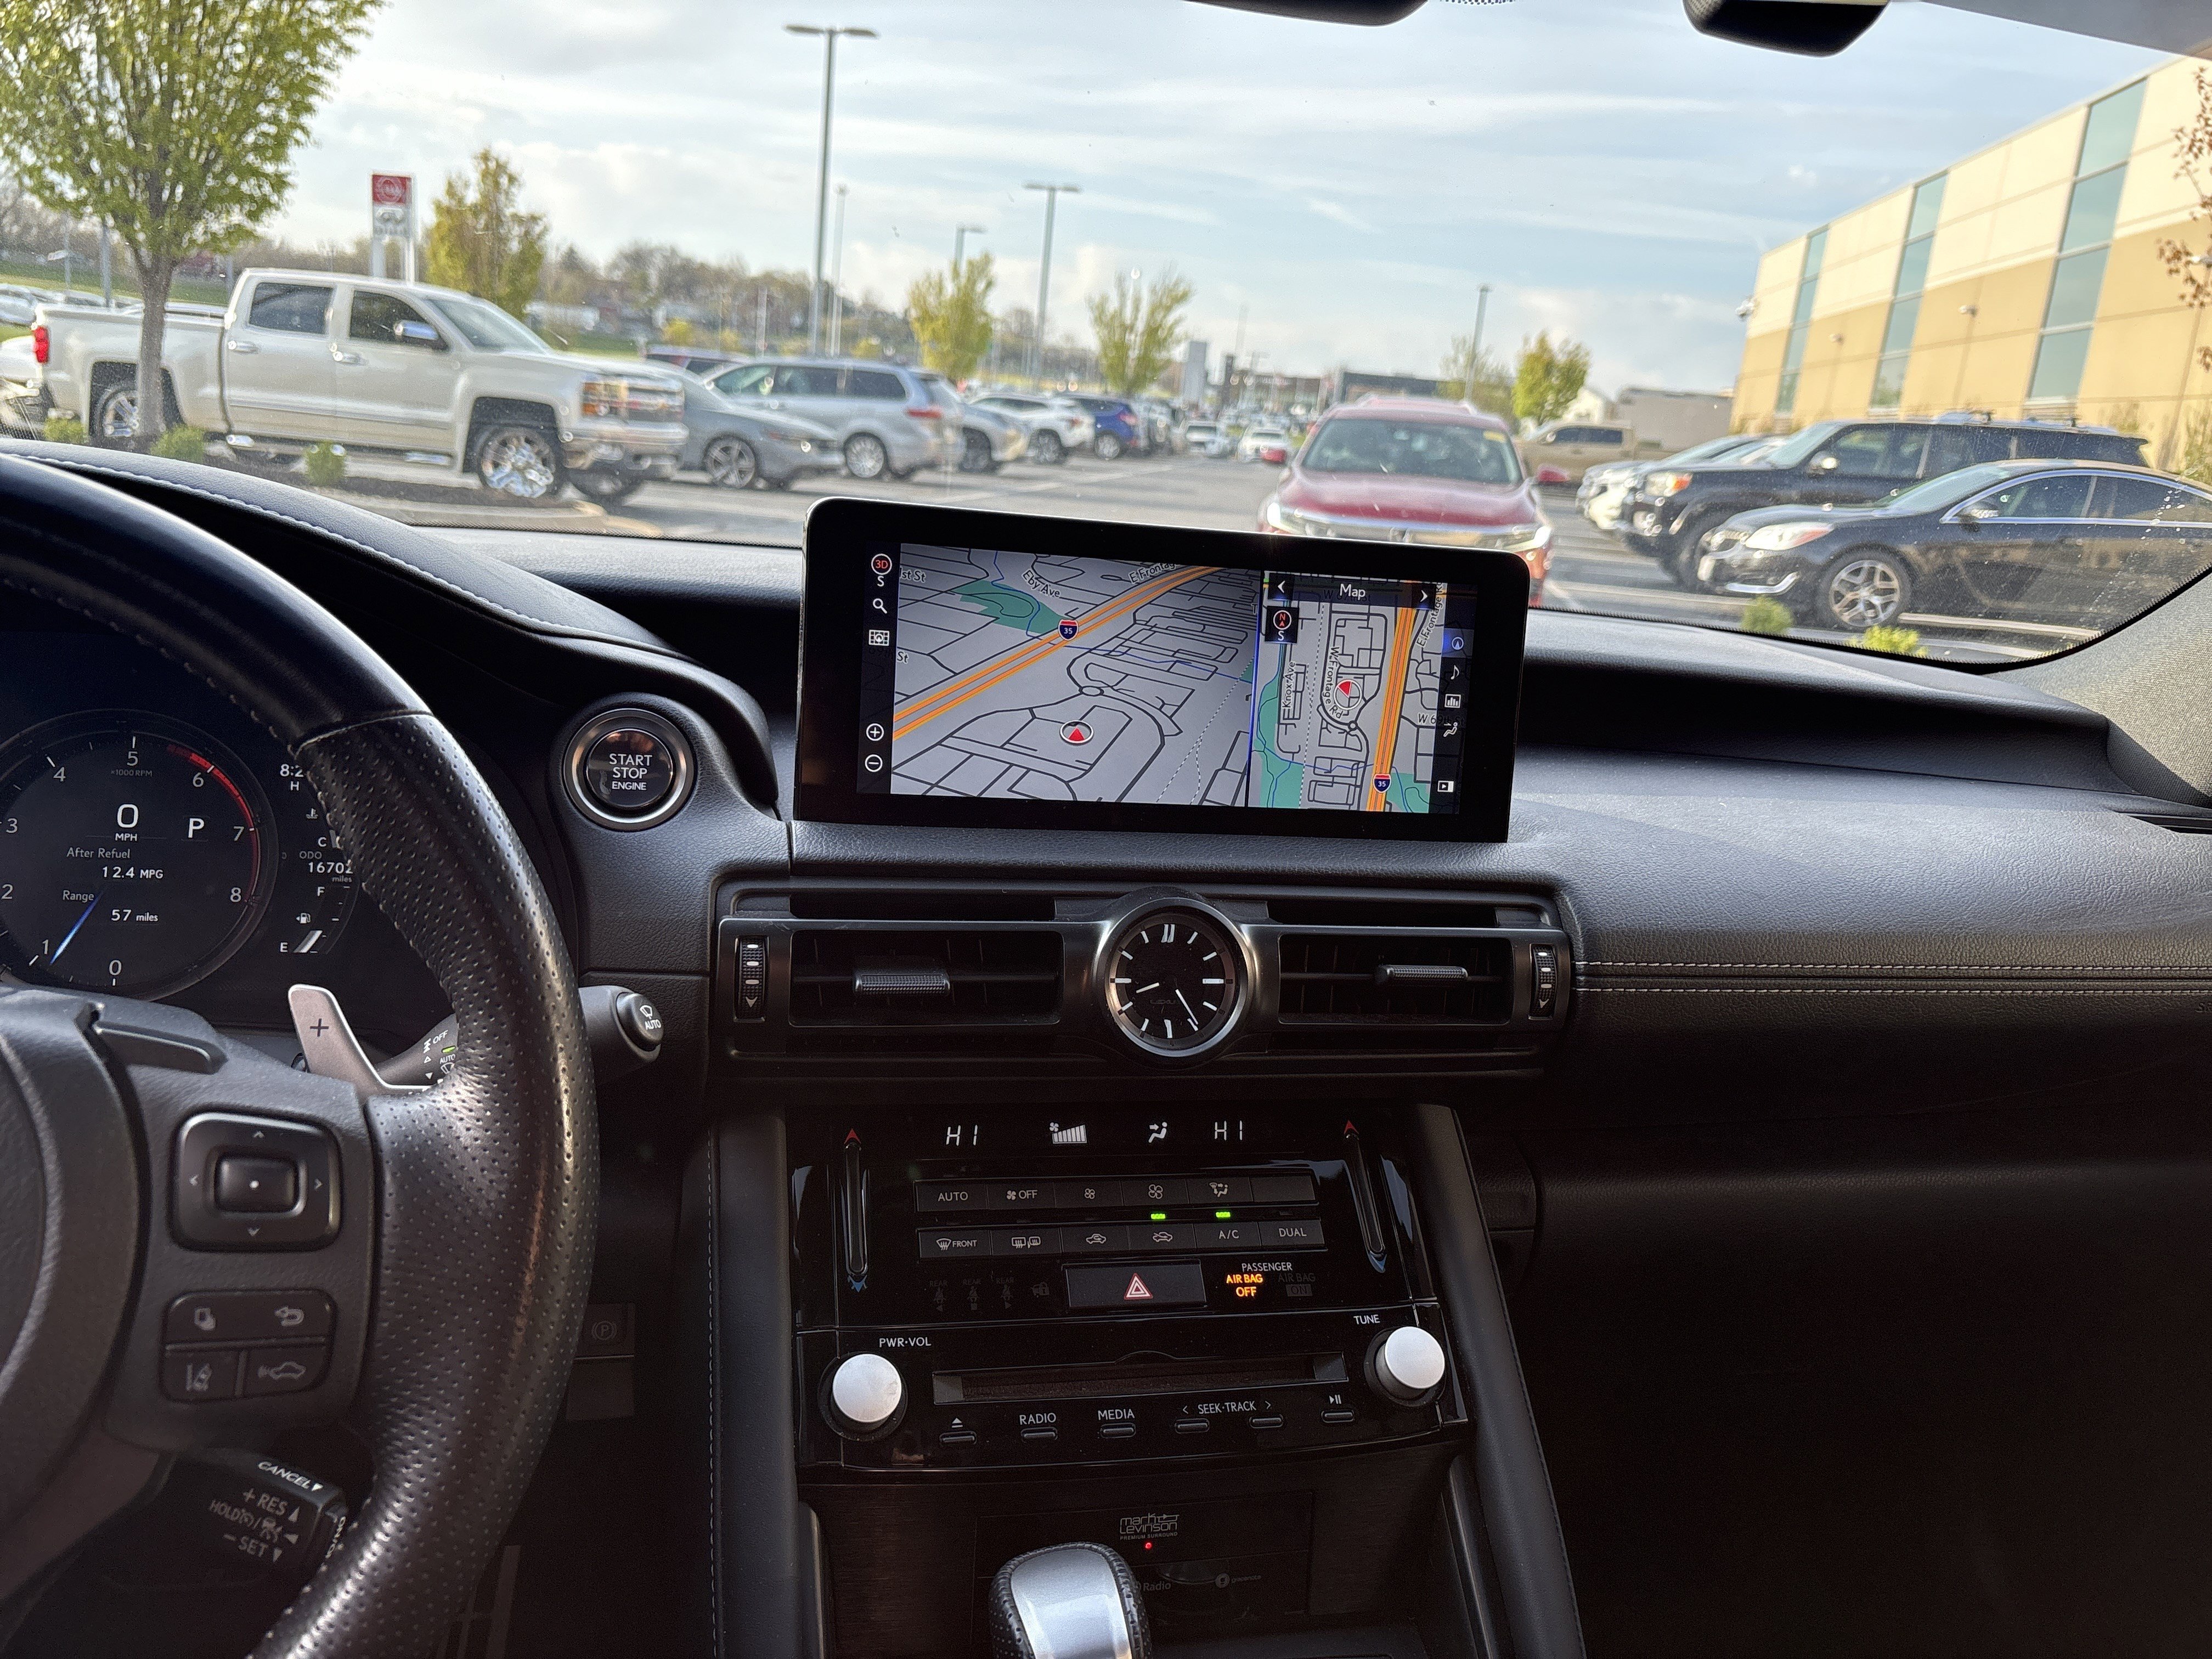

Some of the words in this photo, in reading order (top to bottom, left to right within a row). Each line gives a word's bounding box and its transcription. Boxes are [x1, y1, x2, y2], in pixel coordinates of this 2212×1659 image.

[875, 560, 888, 569] 3D
[877, 575, 884, 587] S
[914, 570, 925, 583] St
[1130, 572, 1138, 583] E
[1023, 569, 1041, 591] Eby
[1041, 584, 1060, 598] Ave
[1339, 583, 1366, 601] Map
[1417, 637, 1425, 646] E
[1421, 596, 1443, 637] Frontage
[1277, 630, 1284, 641] S
[897, 651, 908, 663] St
[1284, 662, 1295, 681] Ave
[1322, 660, 1339, 704] Frontage
[1282, 684, 1293, 708] Knox
[1329, 704, 1344, 719] Rd
[1418, 713, 1428, 723] W
[127, 751, 138, 766] 5
[609, 753, 653, 766] START
[53, 768, 66, 782] 4
[612, 766, 647, 780] STOP
[192, 772, 205, 788] 6
[290, 781, 300, 791] H
[611, 780, 647, 791] ENGINE
[117, 804, 139, 828] 0
[5, 818, 19, 833] 3
[188, 817, 205, 839] P
[115, 832, 138, 842] MPH
[233, 826, 245, 842] 7
[318, 837, 327, 847] C
[66, 847, 95, 858] After
[98, 848, 131, 859] Refuel
[299, 851, 323, 860] ODO
[103, 866, 135, 879] 12.4
[139, 868, 164, 879] MPG
[1, 884, 14, 900] 2
[62, 889, 95, 904] Range
[229, 887, 242, 903] 8
[317, 886, 325, 897] F
[111, 909, 132, 922] 57
[136, 912, 159, 922] miles
[42, 939, 50, 955] 1
[280, 941, 289, 953] E
[109, 960, 122, 975] 0
[645, 1019, 662, 1030] AUTO
[432, 1029, 449, 1045] OFF
[439, 1053, 456, 1064] AUTO
[945, 1124, 979, 1147] HI
[1214, 1120, 1243, 1141] HI
[938, 1191, 969, 1202] AUTO
[1018, 1189, 1038, 1200] OFF
[1218, 1229, 1240, 1240] A/C
[1278, 1227, 1307, 1238] DUAL
[952, 1240, 978, 1248] FRONT
[1241, 1262, 1293, 1273] PASSENGER
[1226, 1274, 1243, 1284] AIR
[1243, 1273, 1263, 1284] BAG
[1278, 1273, 1295, 1283] AIR
[1295, 1272, 1316, 1283] BAG
[1235, 1286, 1257, 1297] OFF
[1290, 1285, 1308, 1295] ON
[1353, 1314, 1381, 1325] TUNE
[1019, 1412, 1057, 1425] RADIO
[1097, 1408, 1135, 1421] MEDIA
[258, 1461, 312, 1489] CANCEL
[209, 1498, 241, 1521] HOLD
[257, 1492, 289, 1516] RES
[238, 1535, 269, 1558] SET
[1143, 1580, 1172, 1592] Radio
